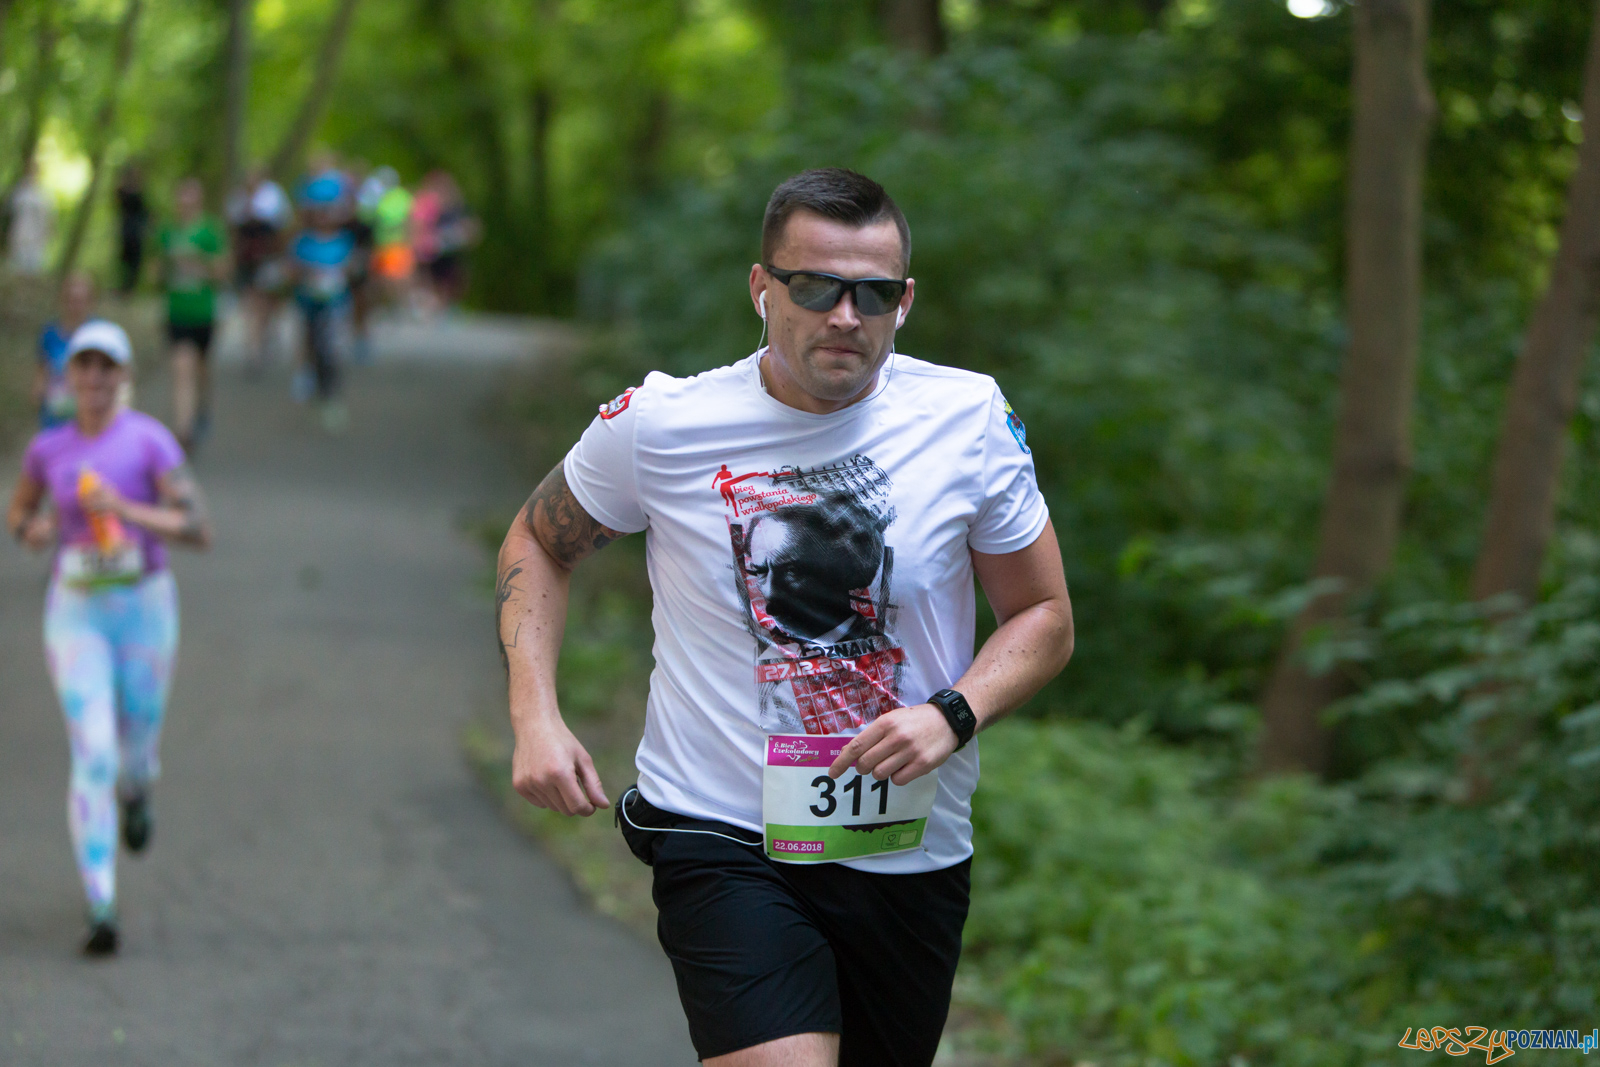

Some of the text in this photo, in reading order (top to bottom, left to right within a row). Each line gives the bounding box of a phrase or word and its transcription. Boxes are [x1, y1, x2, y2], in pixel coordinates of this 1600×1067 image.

[733, 485, 755, 495] bieg
[738, 488, 789, 509] powstania
[741, 493, 817, 515] wielkopolskiego
[809, 775, 889, 818] 311
[775, 841, 822, 852] 22.06.2018
